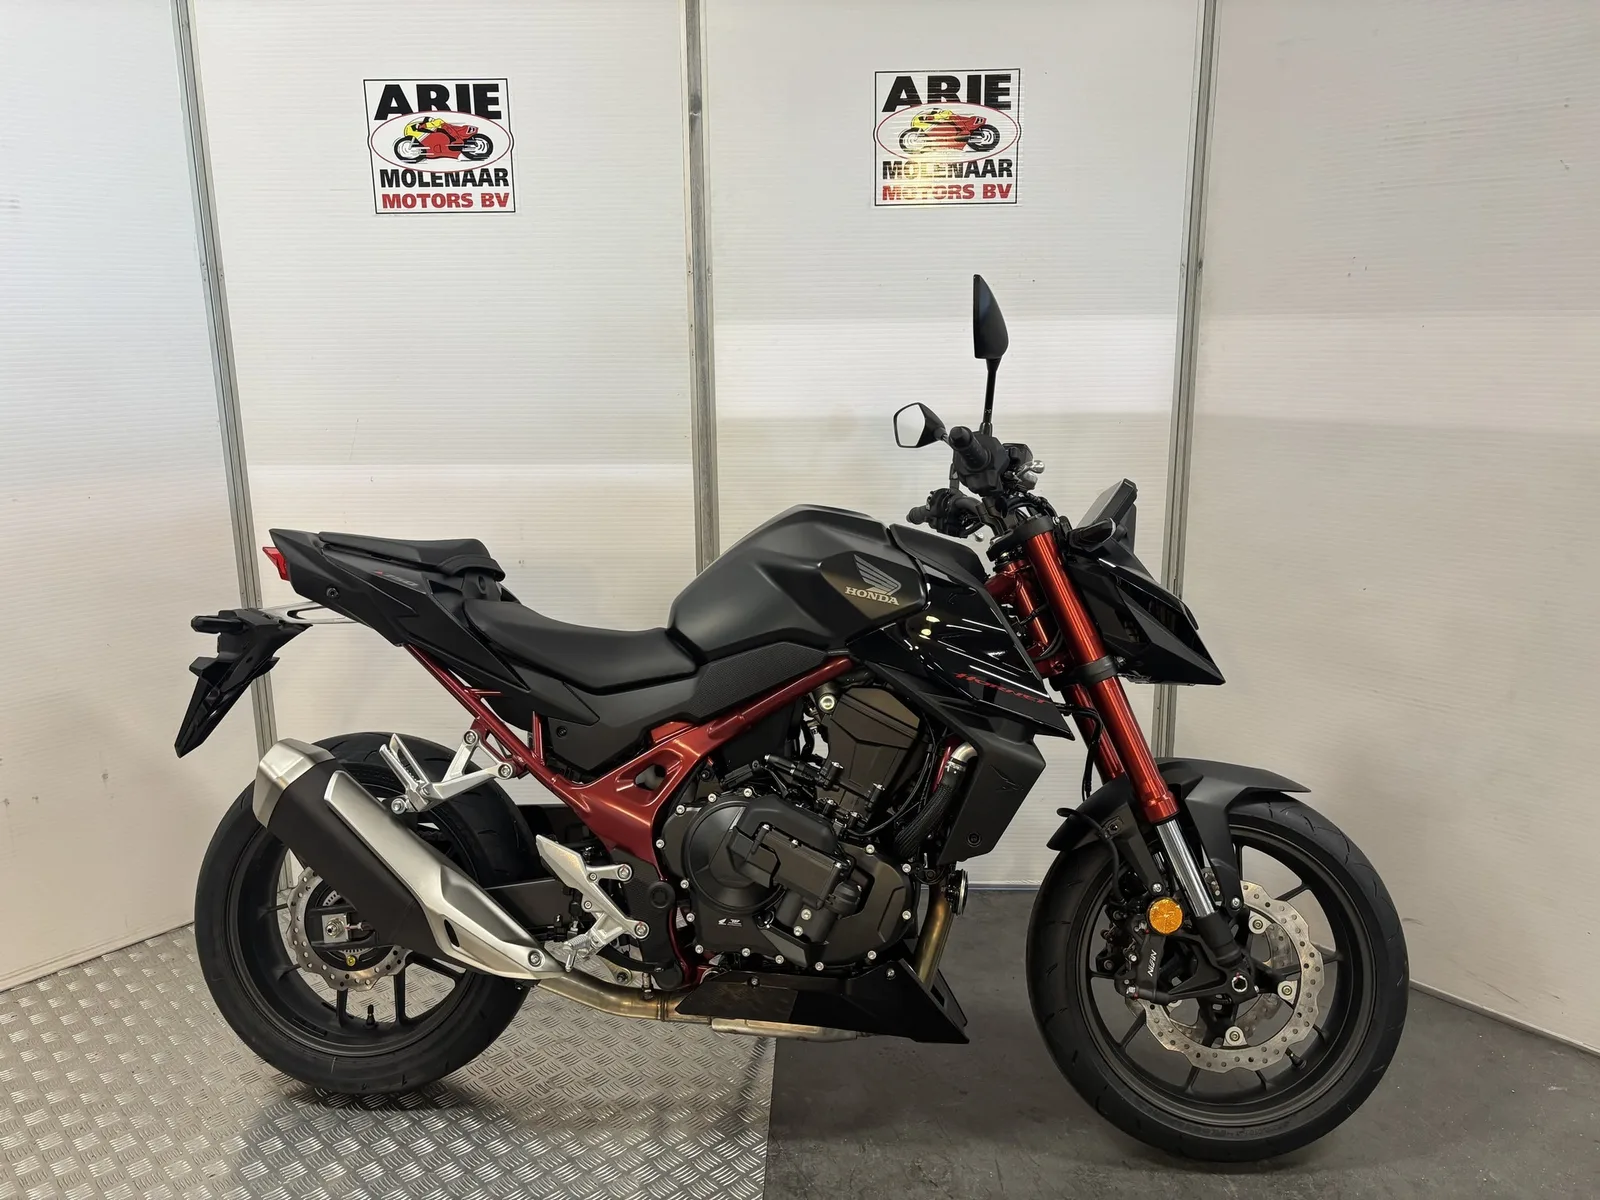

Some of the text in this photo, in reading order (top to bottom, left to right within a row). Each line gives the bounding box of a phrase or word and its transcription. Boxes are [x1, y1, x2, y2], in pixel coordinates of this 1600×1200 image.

[374, 83, 502, 120] ARIE
[881, 73, 1012, 113] ARIE
[379, 168, 510, 188] MOLENAAR
[882, 158, 1013, 180] MOLENAAR
[381, 192, 510, 209] MOTORS BV
[882, 183, 1013, 201] MOTORS BV
[844, 586, 900, 606] HONDA
